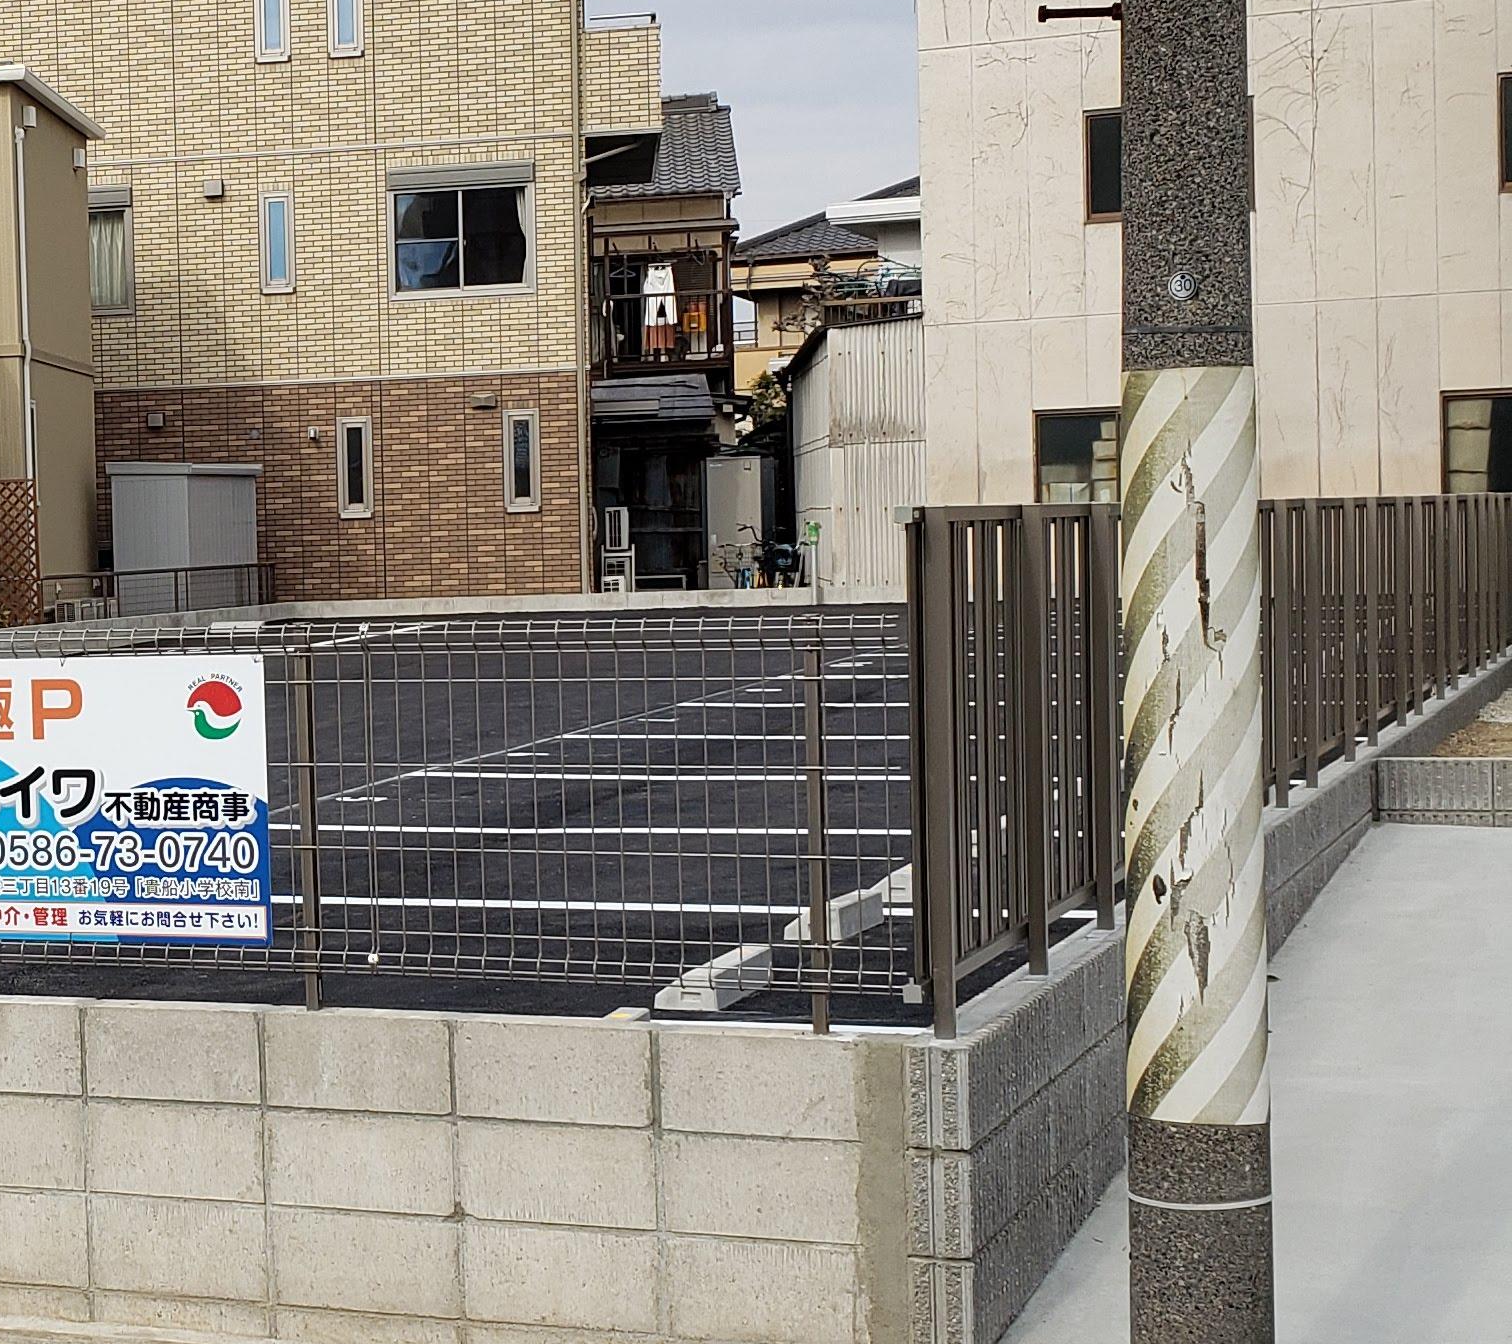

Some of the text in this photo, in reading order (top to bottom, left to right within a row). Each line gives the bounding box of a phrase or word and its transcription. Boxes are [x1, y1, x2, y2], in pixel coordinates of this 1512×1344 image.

[1175, 278, 1192, 292] 30
[188, 673, 243, 692] REAL PARTNER
